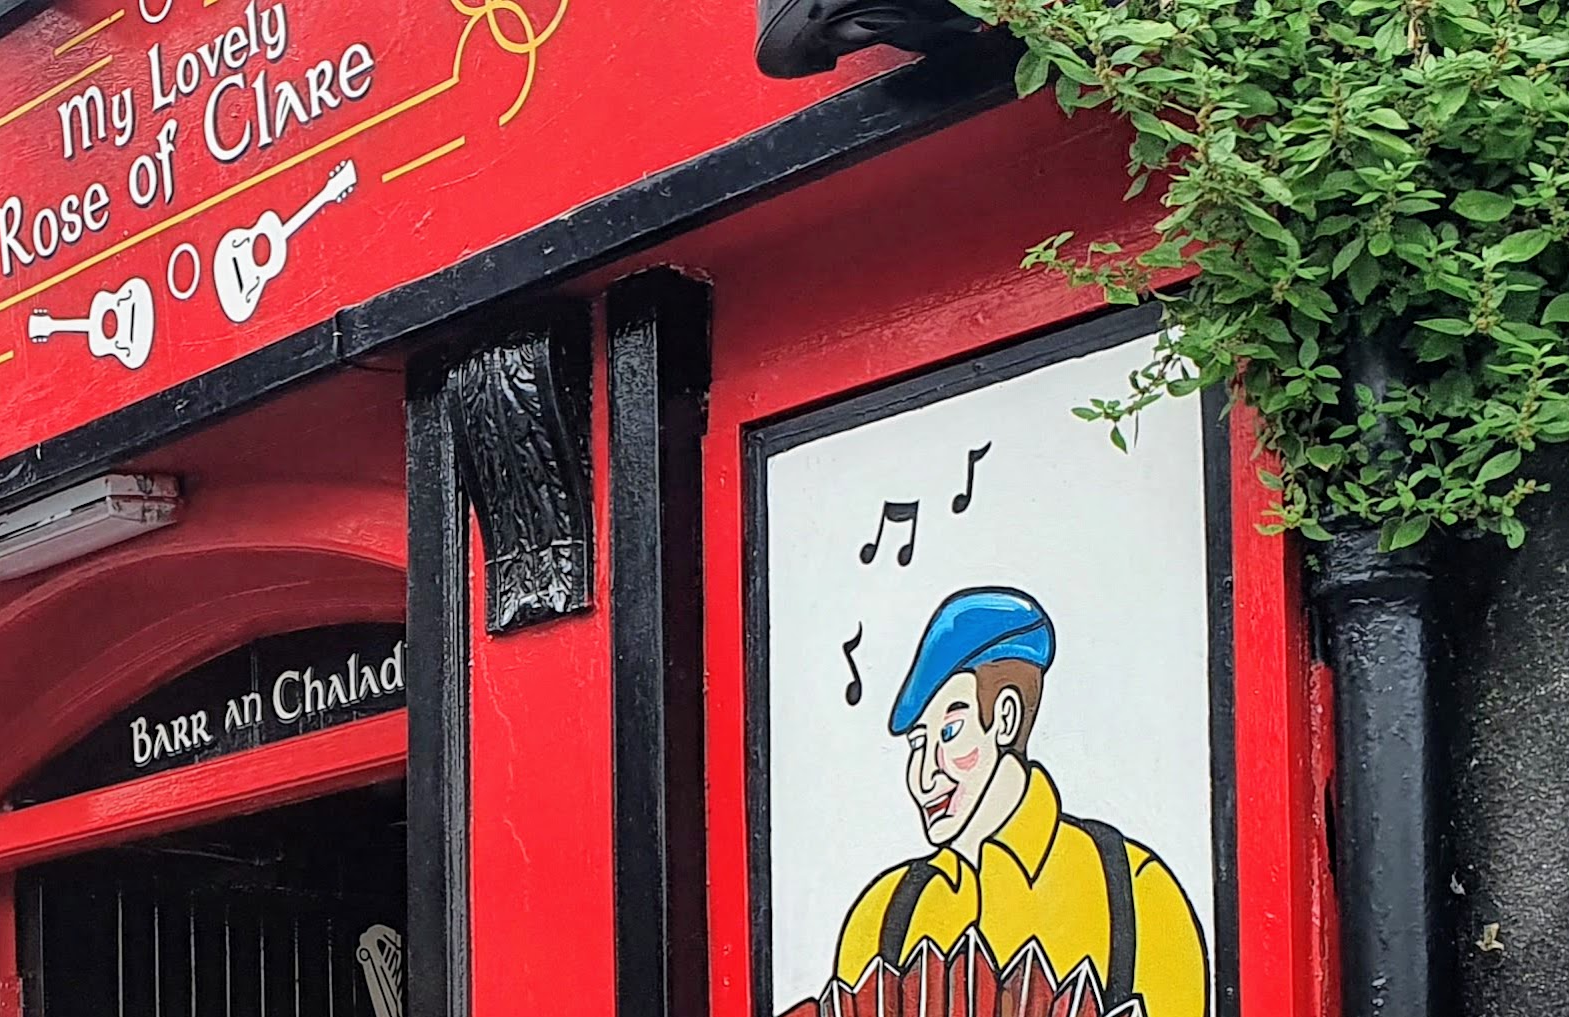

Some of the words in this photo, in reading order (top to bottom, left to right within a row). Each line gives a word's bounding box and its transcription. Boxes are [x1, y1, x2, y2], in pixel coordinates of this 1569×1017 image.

[57, 85, 133, 159] My
[147, 0, 288, 112] Lovely
[128, 118, 178, 206] of
[225, 690, 263, 735] an
[272, 640, 408, 724] Chalad
